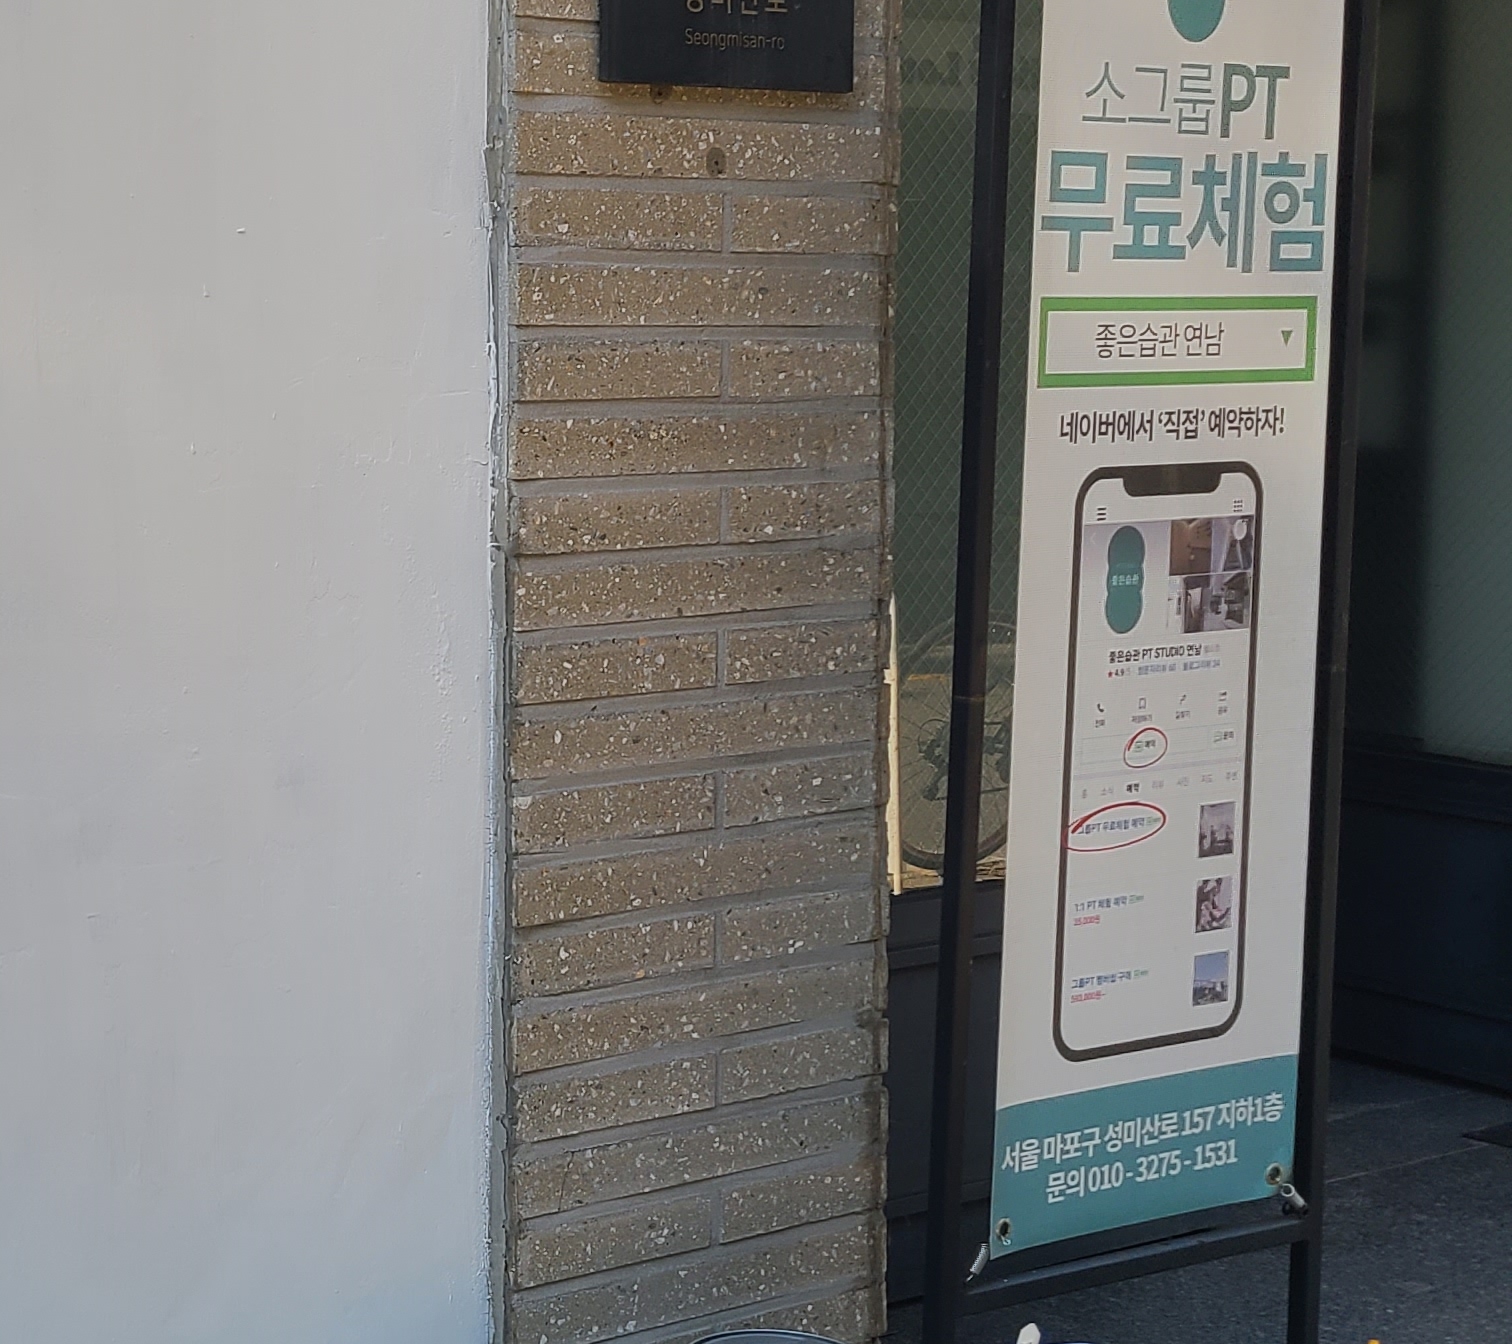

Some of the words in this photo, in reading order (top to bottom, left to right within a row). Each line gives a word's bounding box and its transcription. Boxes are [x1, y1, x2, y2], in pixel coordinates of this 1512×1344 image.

[684, 28, 786, 50] Seongmisan-ro
[1081, 61, 1291, 140] 소그룹PT
[1040, 150, 1329, 274] 무료체험
[1095, 322, 1180, 359] 좋은습관
[1184, 321, 1225, 357] 연남
[1059, 409, 1155, 444] 네이버에서
[1208, 405, 1286, 438] 예약하자!
[1001, 1138, 1041, 1173] 서울
[1043, 1126, 1102, 1164] 마포구
[1104, 1111, 1182, 1154] 성미산로
[1181, 1106, 1217, 1136] 157
[1217, 1091, 1285, 1129] 지하1층
[1046, 1166, 1086, 1204] 문의
